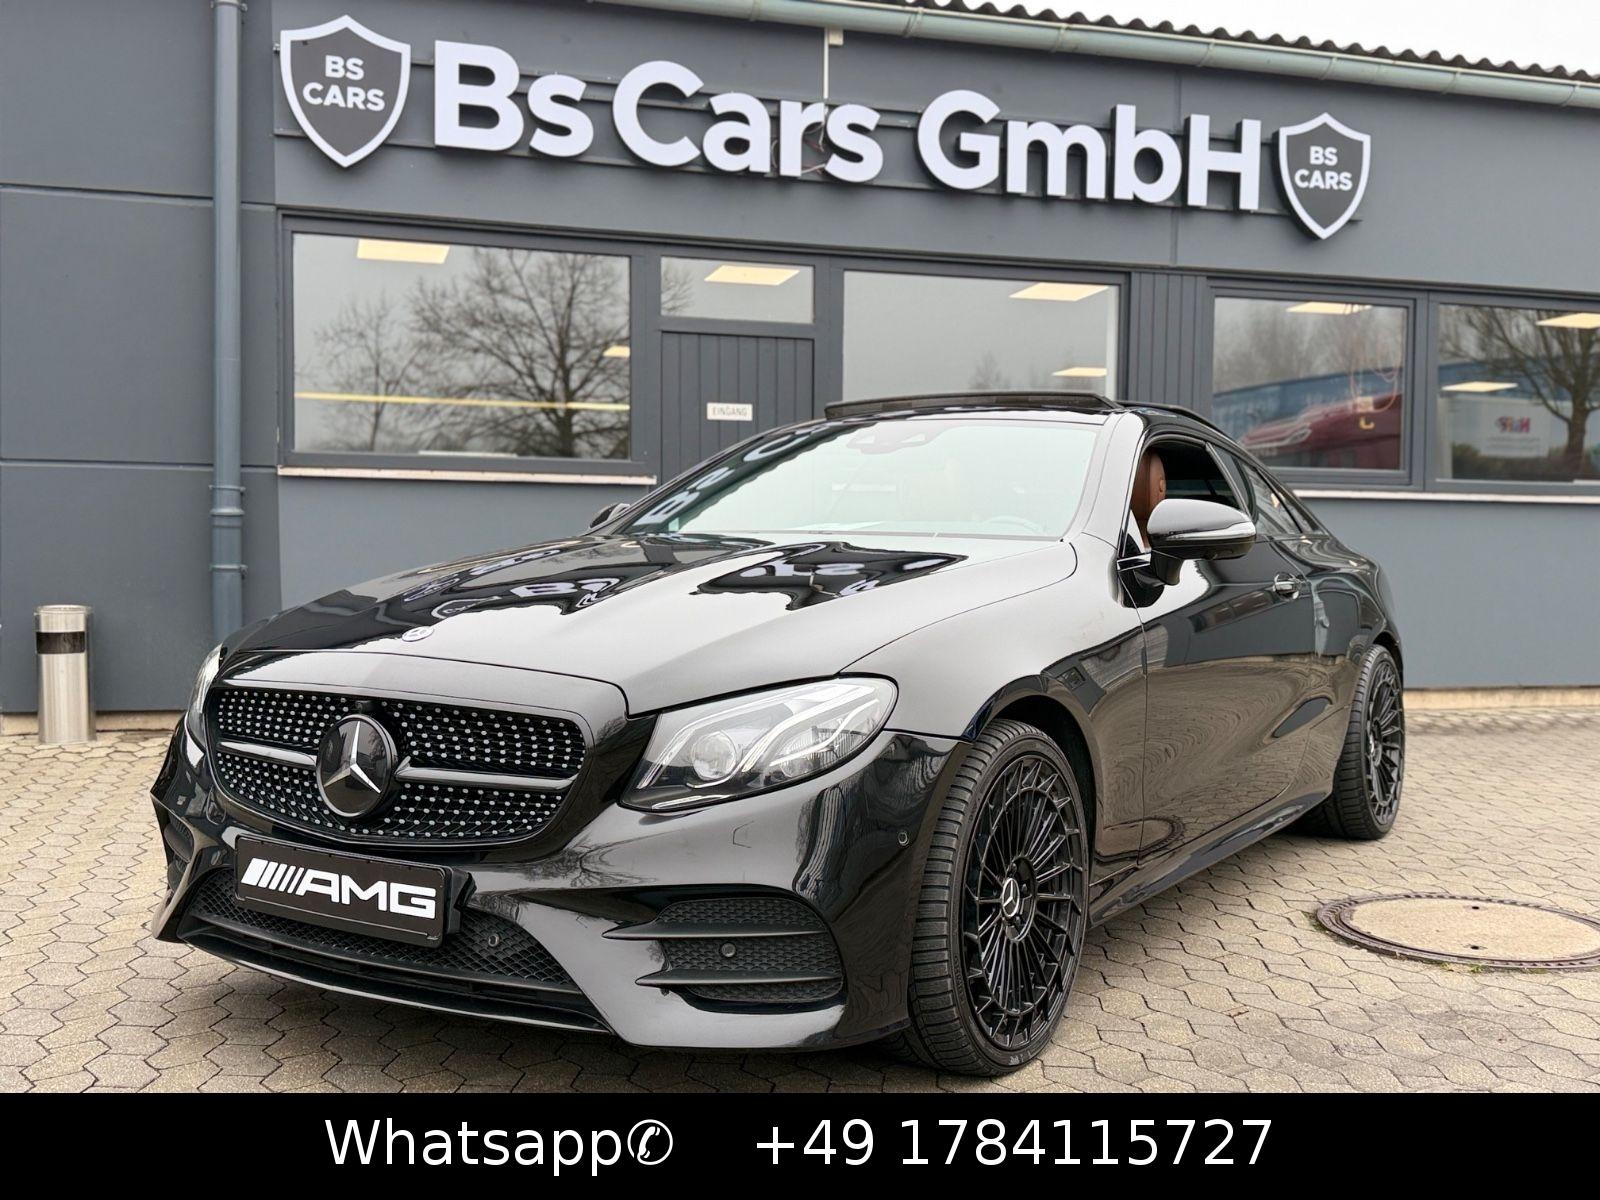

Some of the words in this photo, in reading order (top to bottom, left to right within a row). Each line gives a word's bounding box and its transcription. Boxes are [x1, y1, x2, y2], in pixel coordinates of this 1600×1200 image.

[324, 54, 365, 81] BS
[302, 82, 386, 112] CARS
[434, 40, 595, 158] Bs
[612, 60, 884, 183] Cars
[917, 89, 1262, 211] GmbH
[1309, 145, 1339, 166] BS
[1295, 168, 1353, 191] CARS
[711, 405, 748, 417] EINGANG
